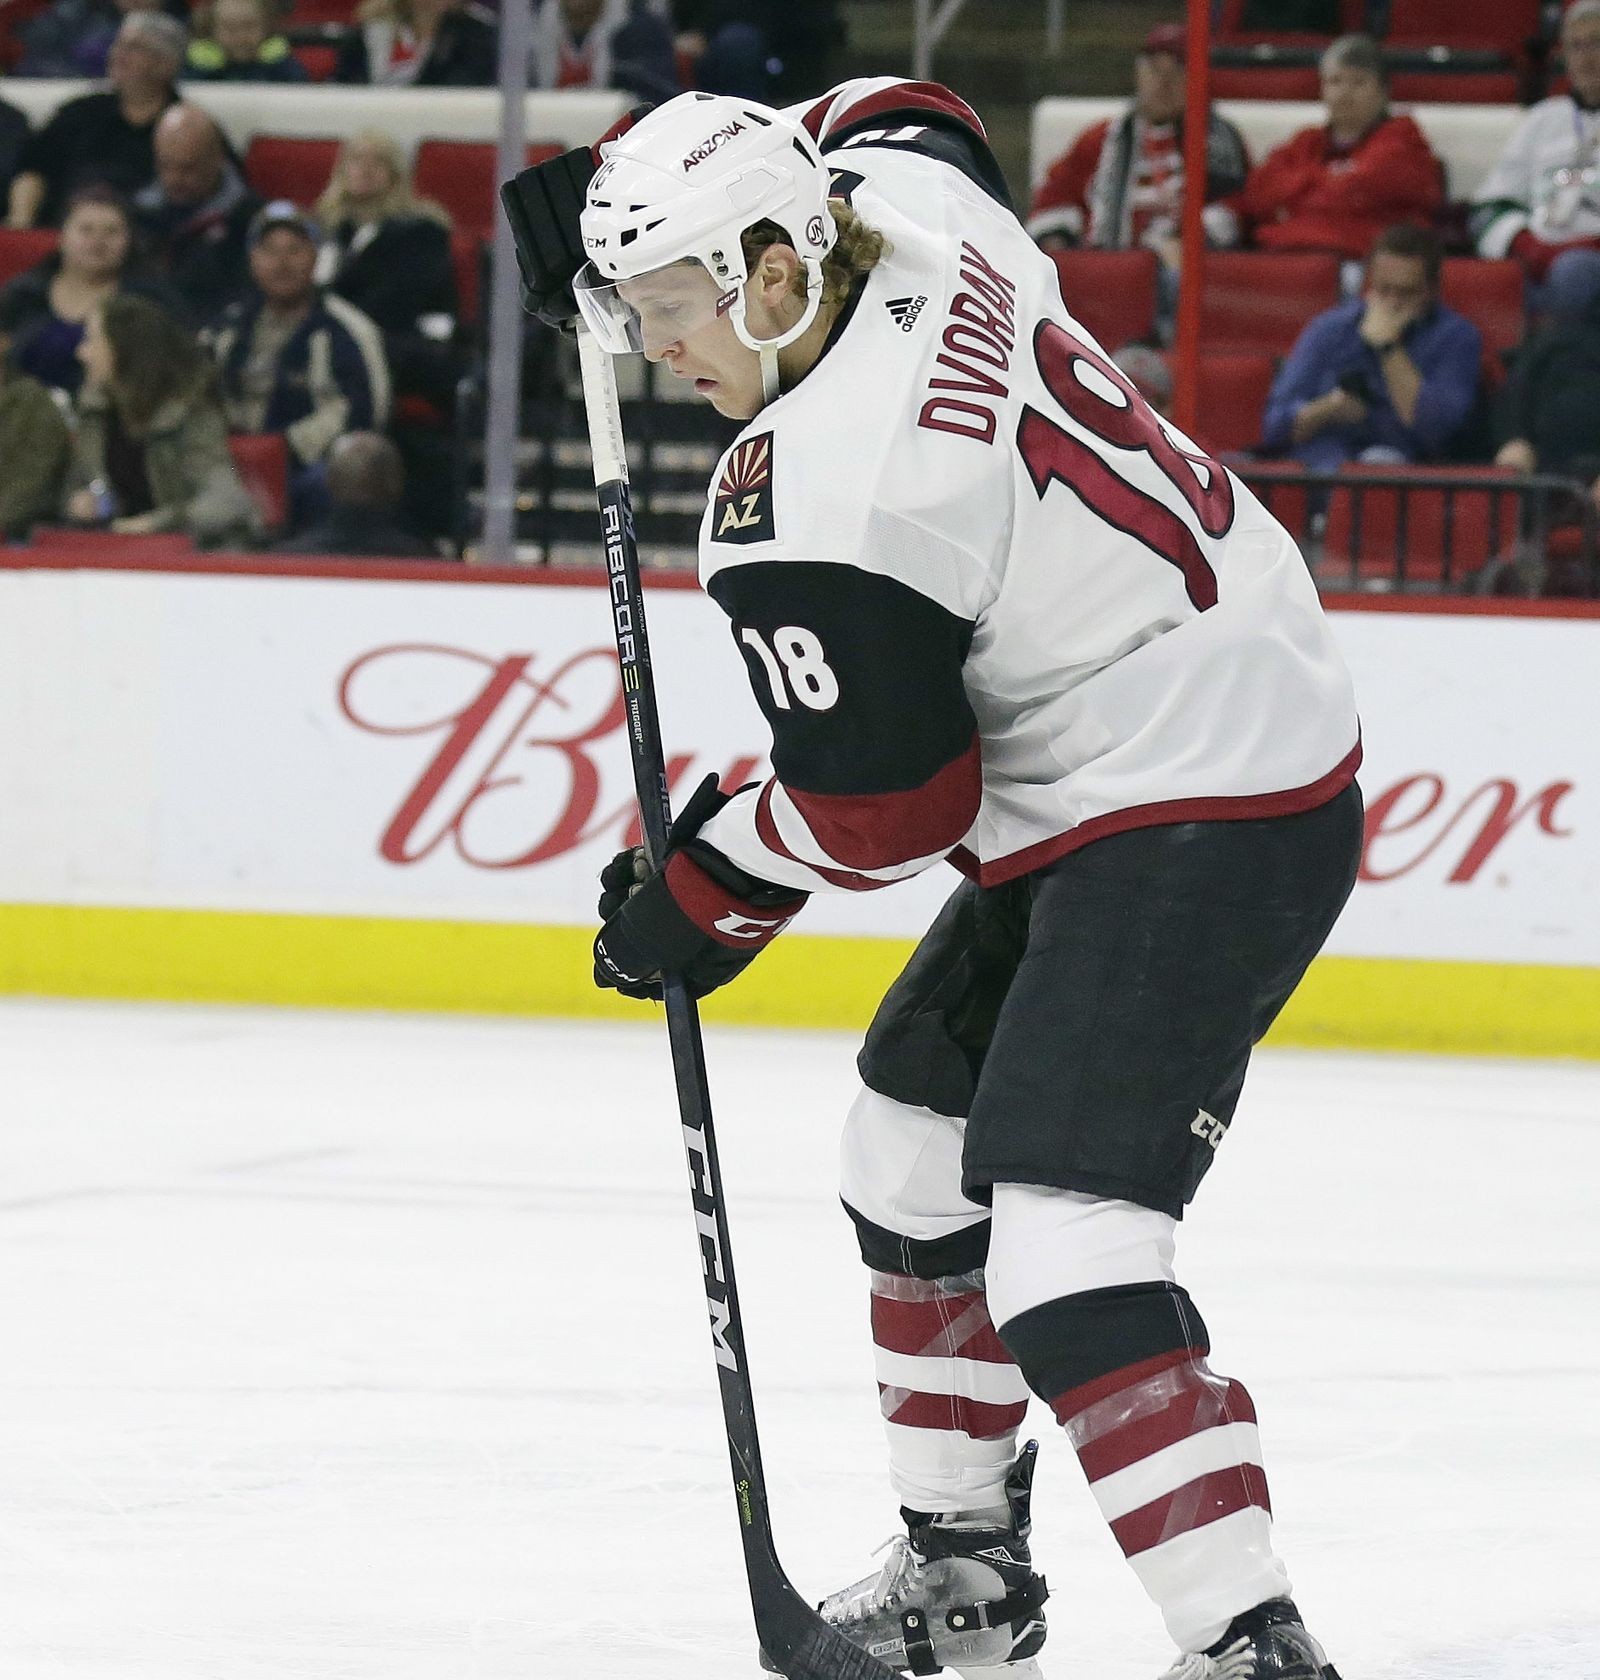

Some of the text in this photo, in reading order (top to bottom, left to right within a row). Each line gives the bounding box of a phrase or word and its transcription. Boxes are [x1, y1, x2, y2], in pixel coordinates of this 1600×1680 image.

[681, 120, 747, 173] ARIZONA
[901, 294, 929, 333] adidas
[917, 239, 1017, 446] DVORAK
[717, 492, 763, 537] AZ
[1015, 316, 1236, 614] 18
[602, 503, 637, 665] RIBCOR
[741, 625, 840, 711] 18
[682, 1122, 738, 1373] CCM
